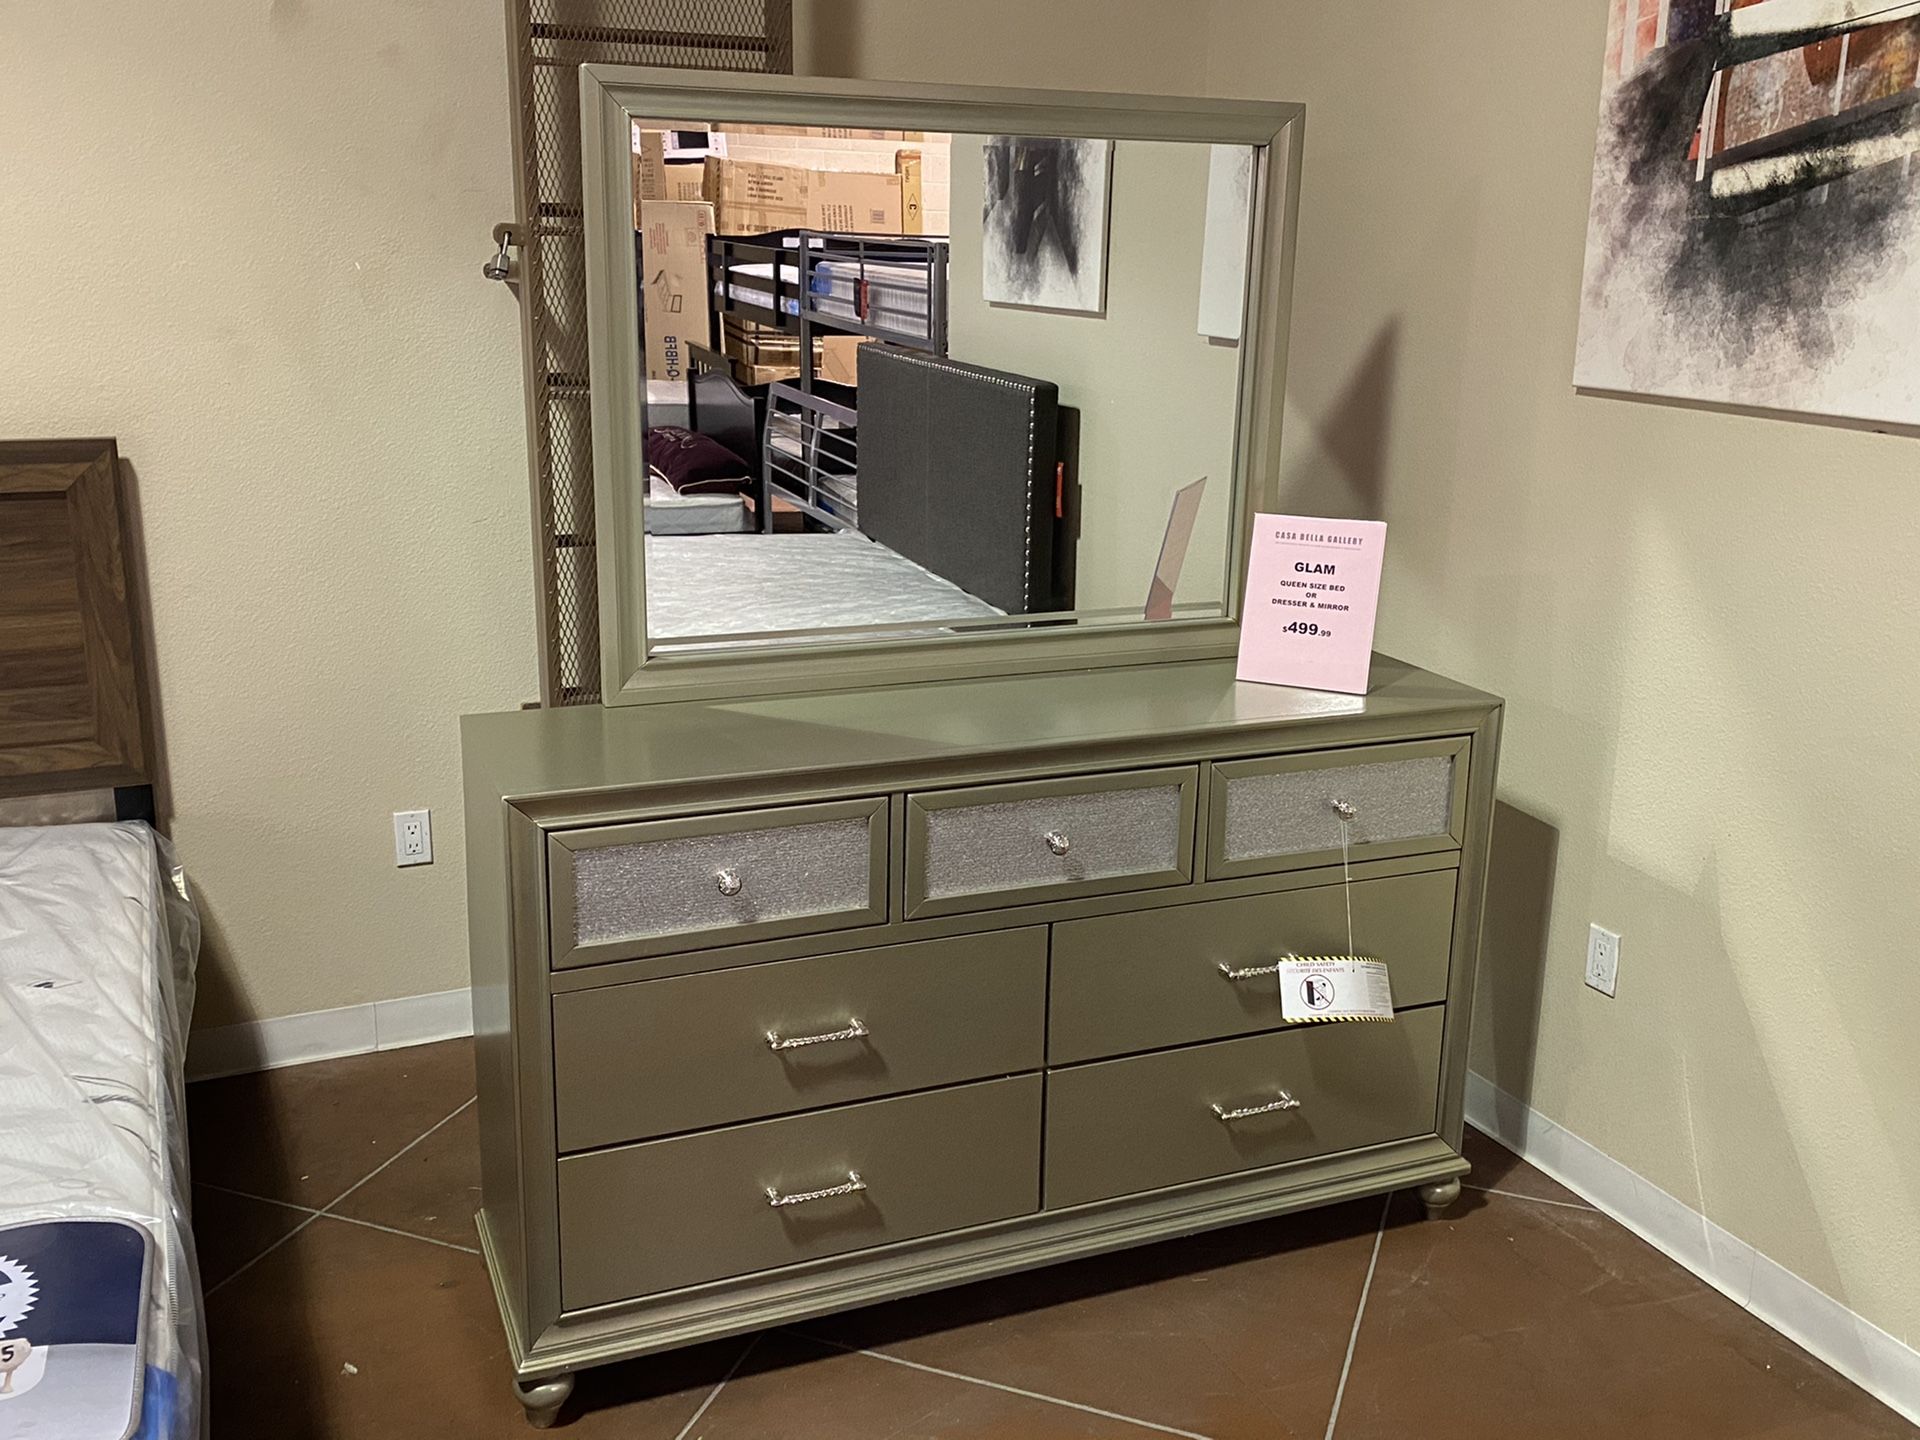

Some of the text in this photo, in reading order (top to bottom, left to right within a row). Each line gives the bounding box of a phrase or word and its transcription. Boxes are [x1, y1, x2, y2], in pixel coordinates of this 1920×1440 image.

[1275, 531, 1363, 546] CASA BELLA GALLERY
[1294, 562, 1336, 575] GLAM
[1280, 580, 1346, 592] QUEEN SIZE BED
[1272, 598, 1308, 608] DRESSER
[1317, 602, 1350, 612] MIRROR
[1282, 621, 1332, 637] $499.99
